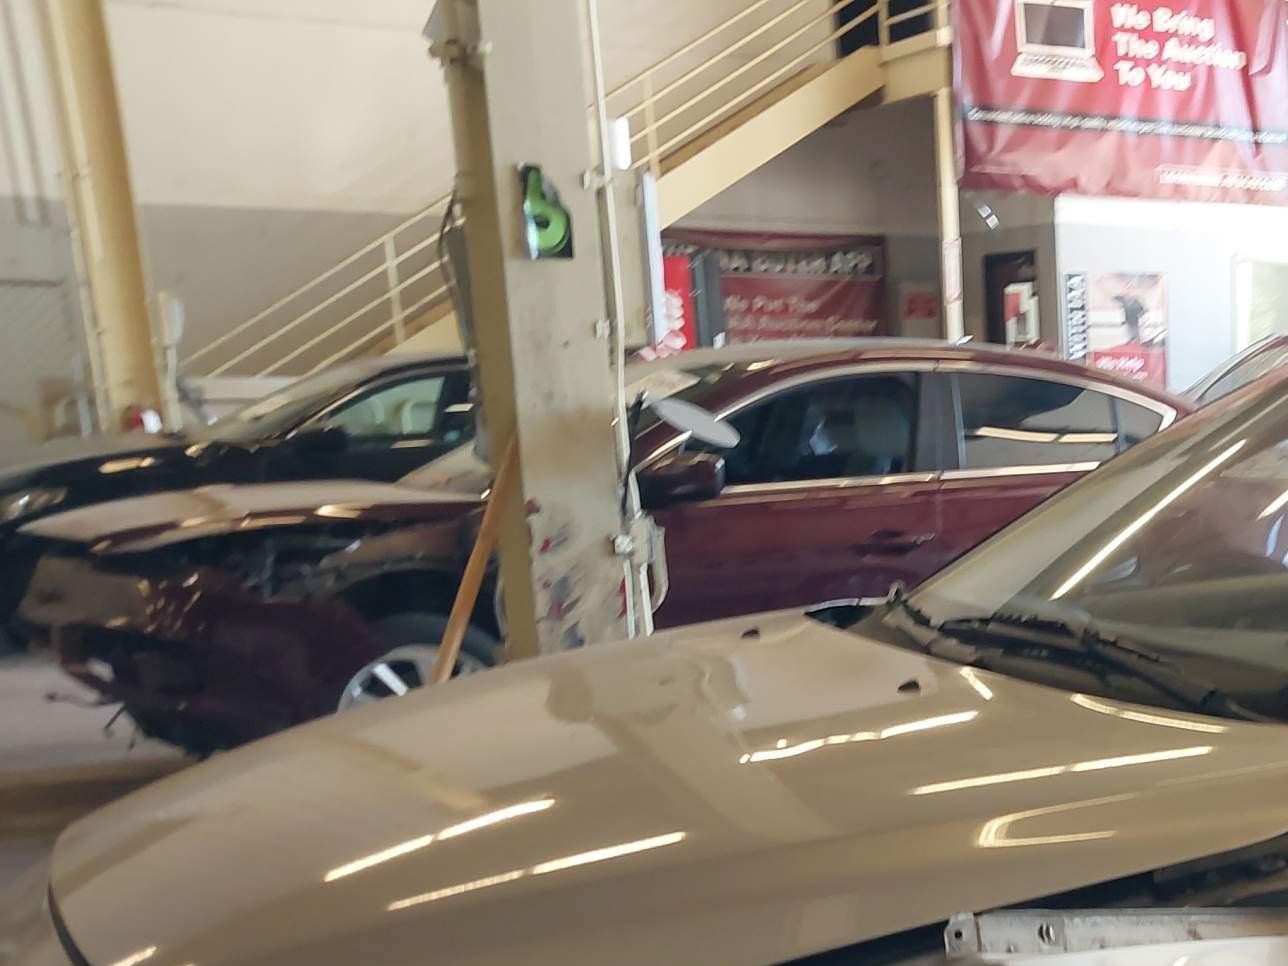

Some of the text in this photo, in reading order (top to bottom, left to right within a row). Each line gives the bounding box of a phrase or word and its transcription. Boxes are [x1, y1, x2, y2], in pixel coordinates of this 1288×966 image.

[1110, 2, 1216, 42] We Bring
[1112, 31, 1160, 60] The
[1113, 60, 1192, 91] To You
